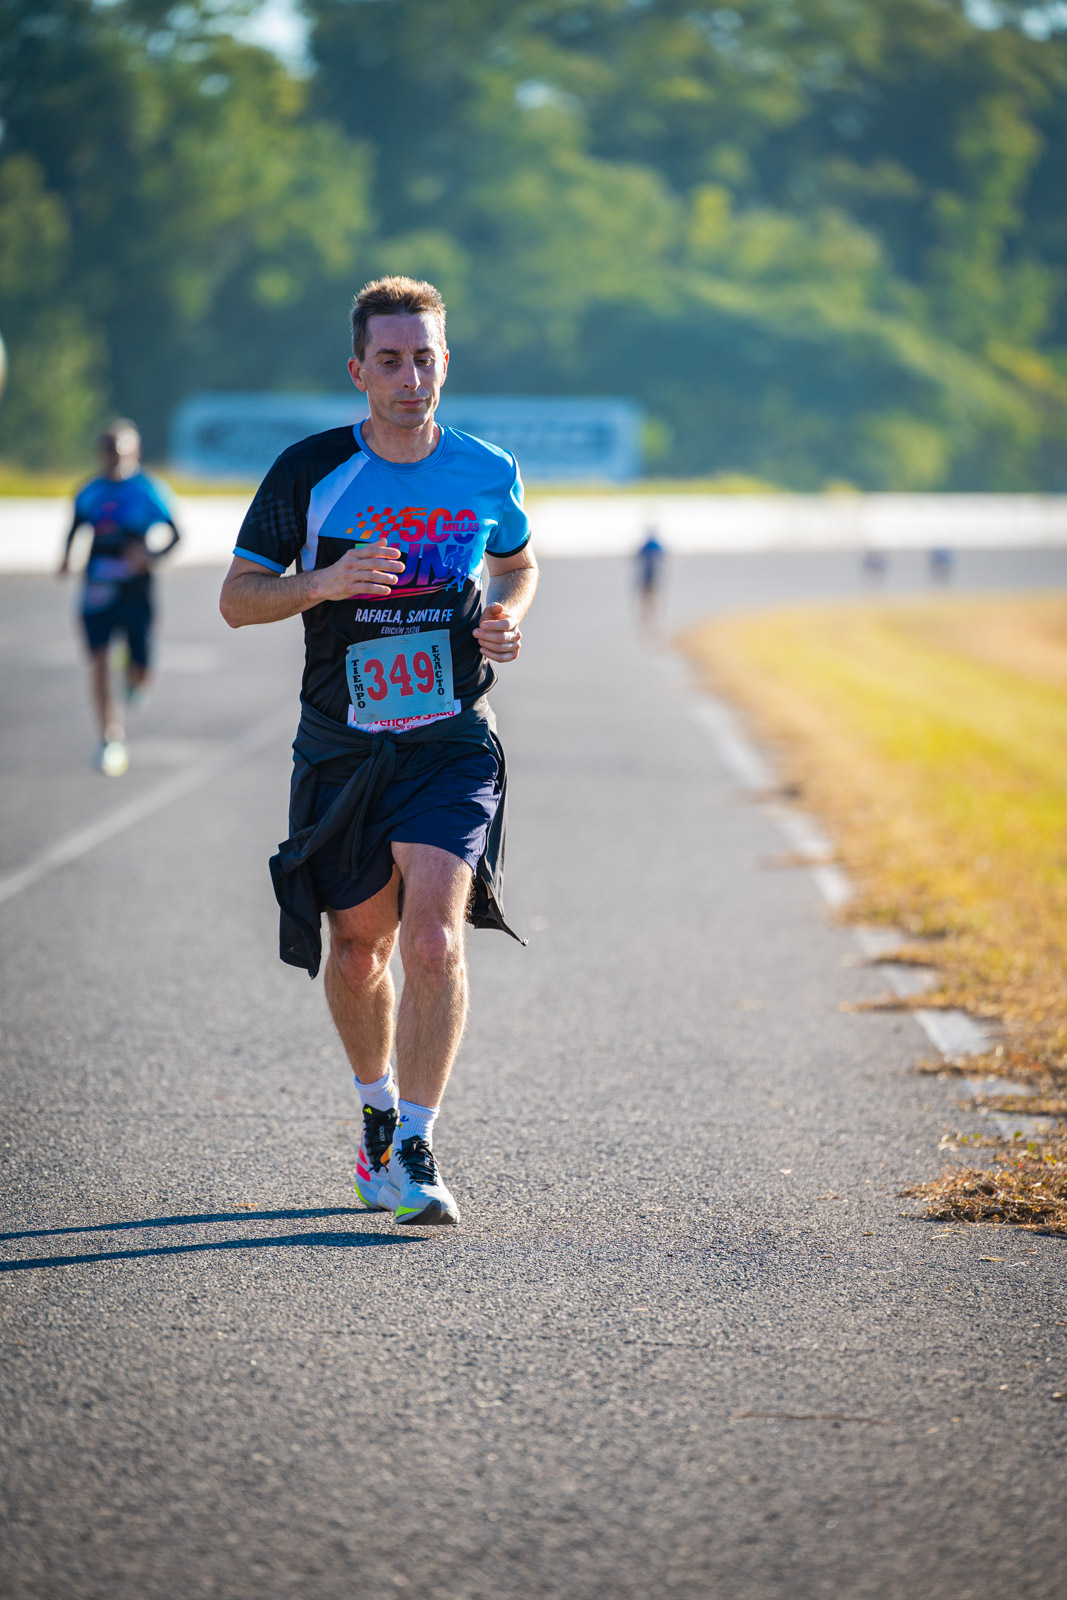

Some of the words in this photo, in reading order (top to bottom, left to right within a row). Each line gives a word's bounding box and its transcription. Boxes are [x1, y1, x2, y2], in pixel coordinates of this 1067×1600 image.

[399, 507, 477, 543] 500
[442, 522, 480, 533] MILLAS
[355, 543, 473, 586] UN
[355, 608, 403, 624] RAFAELA,
[406, 608, 440, 623] SANTA
[440, 608, 454, 622] FE
[351, 659, 366, 709] TIEMPO
[364, 651, 435, 701] 349
[431, 645, 445, 695] EXACTO
